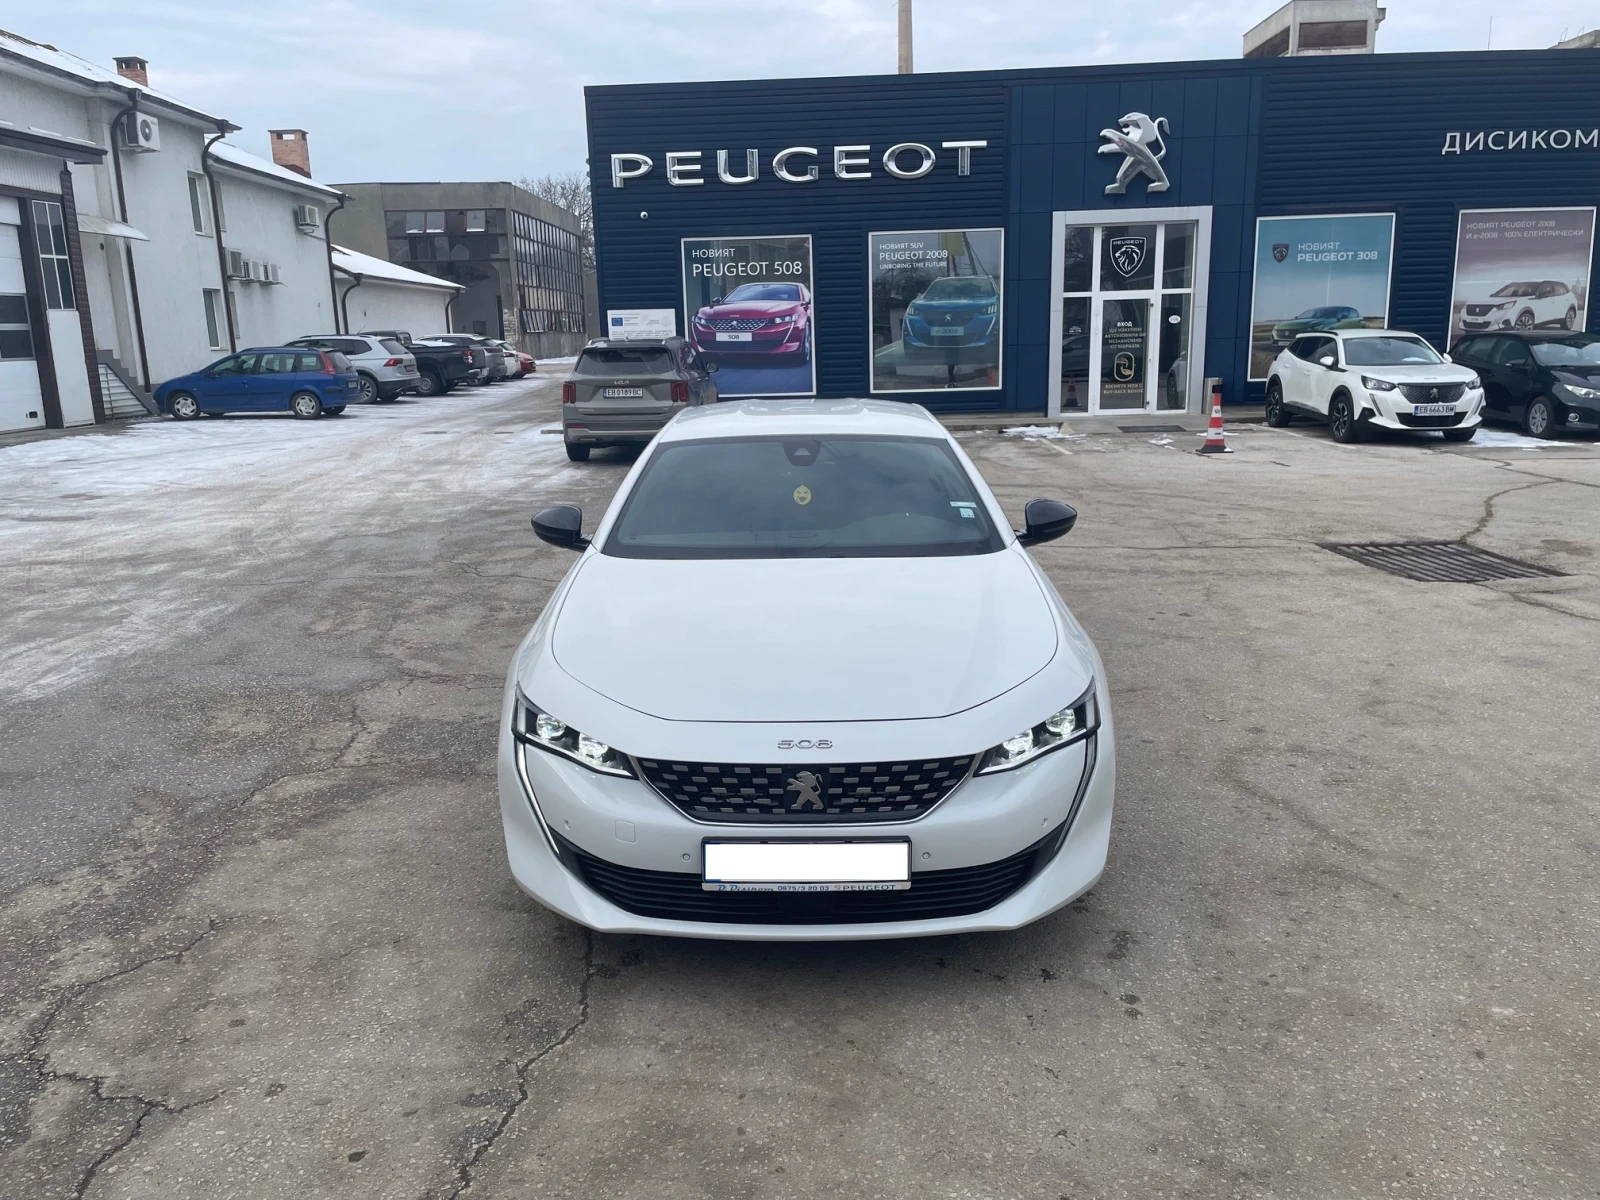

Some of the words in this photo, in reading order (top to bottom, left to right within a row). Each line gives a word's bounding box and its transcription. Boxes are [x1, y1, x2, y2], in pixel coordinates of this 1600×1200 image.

[1441, 129, 1599, 155] ДИСИКОМ
[611, 140, 988, 188] PEUGEOT
[1467, 221, 1499, 230] НОВИЯТ
[1501, 220, 1536, 228] PEUGEOT
[1524, 230, 1584, 238] ЕЛЕКТРИЧЕСКИ
[880, 242, 909, 250] НОВИЯТ
[1298, 242, 1340, 251] НОВИЯТ
[692, 248, 735, 258] НОВИЯТ
[880, 250, 924, 261] PEUGEOT
[926, 250, 948, 259] 2008
[1297, 252, 1354, 262] PEUGEOT
[1356, 251, 1378, 260] 308
[692, 261, 769, 277] PEUGEOT
[774, 261, 802, 275] 508
[777, 739, 833, 749] 508
